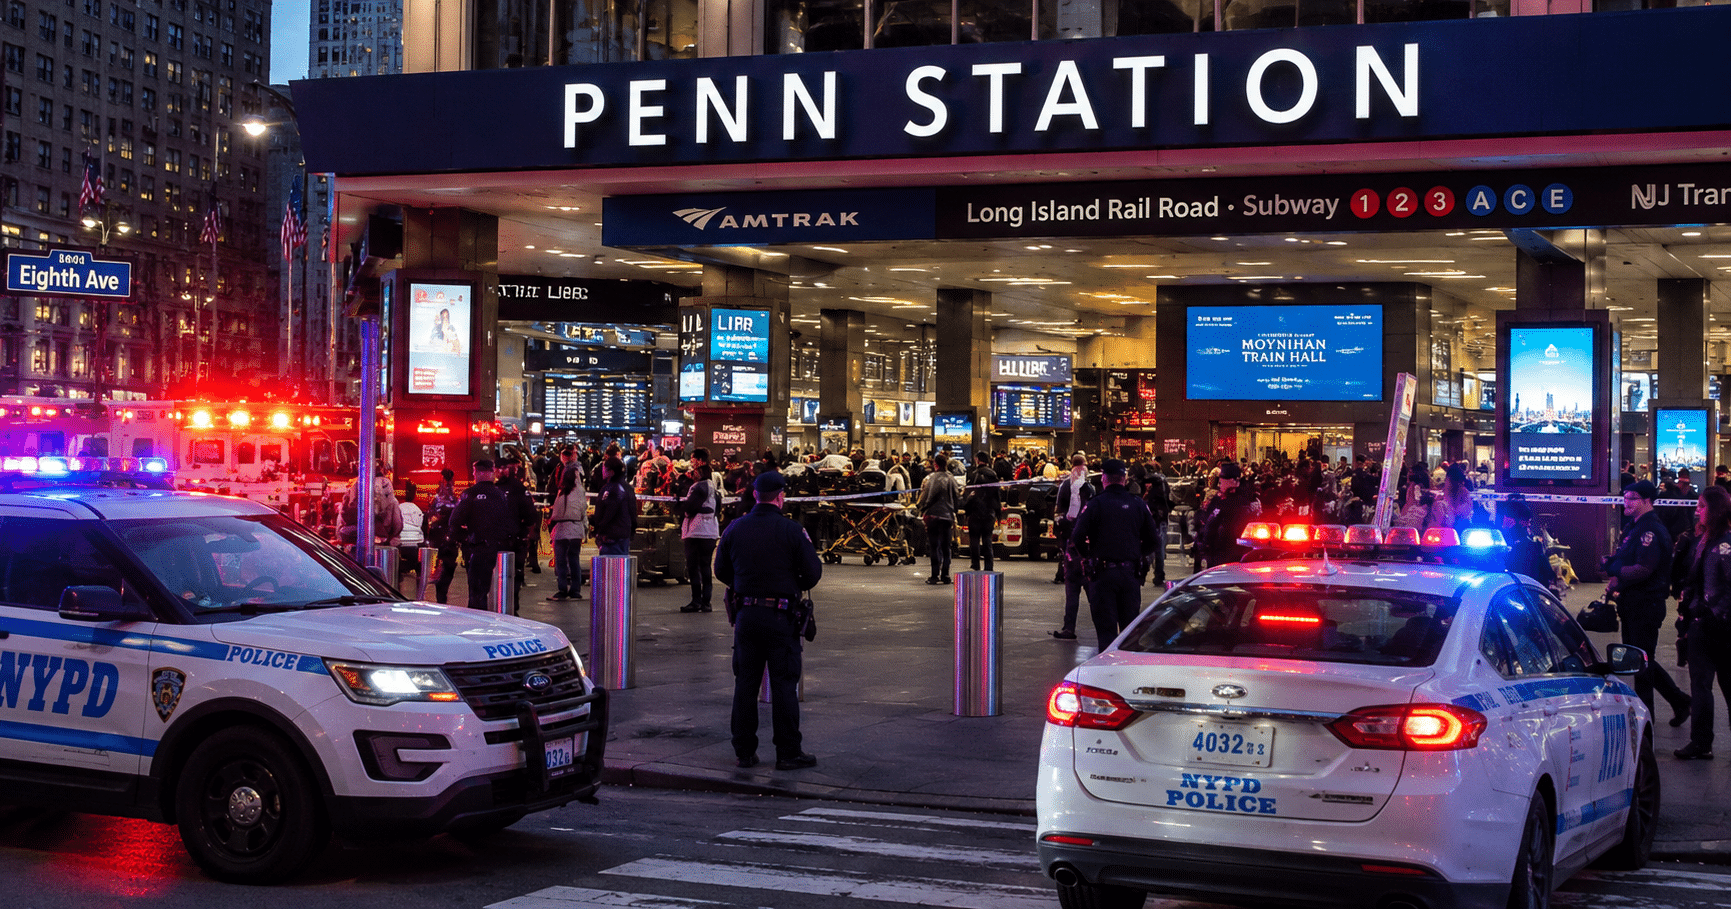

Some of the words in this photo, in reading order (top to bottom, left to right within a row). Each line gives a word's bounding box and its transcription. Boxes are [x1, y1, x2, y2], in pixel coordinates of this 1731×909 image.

[563, 70, 837, 149] PENN
[903, 42, 1420, 138] STATION
[718, 211, 859, 229] AMTRAK
[966, 202, 1024, 228] Long
[1031, 198, 1100, 222] Island
[1108, 196, 1151, 220] Rail
[1158, 195, 1220, 219] Road
[1242, 193, 1340, 220] Subway
[1471, 190, 1491, 211] A
[1511, 189, 1527, 209] C
[1550, 188, 1565, 209] E
[19, 264, 81, 291] Eighth
[85, 269, 119, 290] Ave
[1241, 338, 1327, 350] MOYNIHAN
[1241, 351, 1285, 363] TRAIN
[1290, 350, 1327, 362] HALL
[226, 645, 299, 671] POLICE
[483, 638, 548, 659] POLICE
[0, 650, 119, 719] NYPD
[1192, 731, 1244, 754] 4032
[1180, 772, 1262, 794] NYPD
[1166, 789, 1277, 815] POLICE
